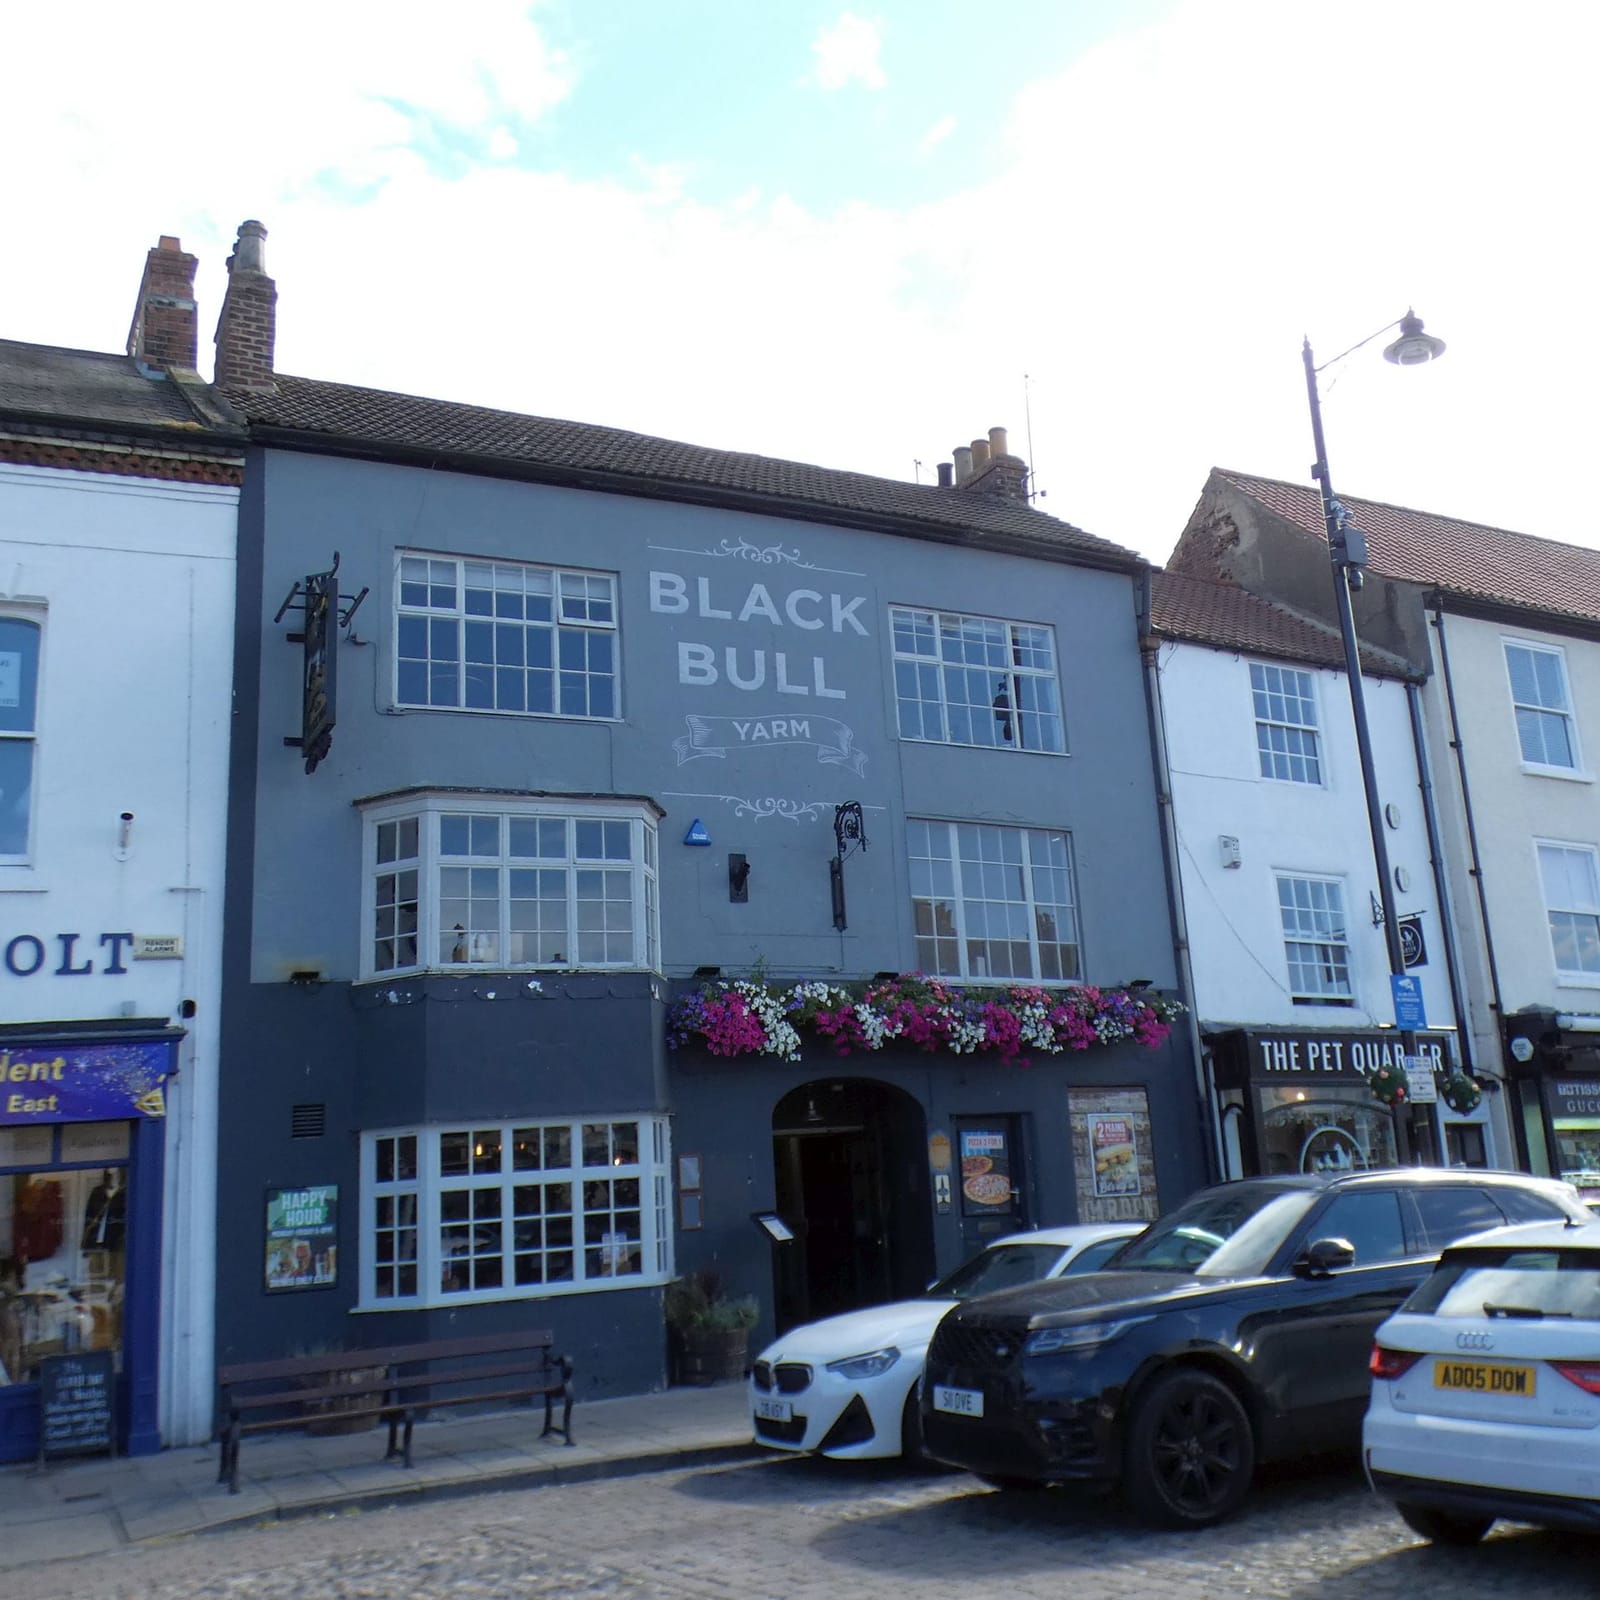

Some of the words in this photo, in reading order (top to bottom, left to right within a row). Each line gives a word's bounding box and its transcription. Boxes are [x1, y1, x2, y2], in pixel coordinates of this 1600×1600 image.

[649, 570, 870, 637] BLACK
[677, 641, 847, 700] BULL
[732, 719, 812, 741] YARM
[1260, 1041, 1301, 1071] THE
[1307, 1042, 1343, 1072] PET
[7, 1094, 58, 1113] East
[1097, 1123, 1105, 1138] 2
[282, 1190, 327, 1210] HAPPY
[286, 1208, 323, 1227] HOUR
